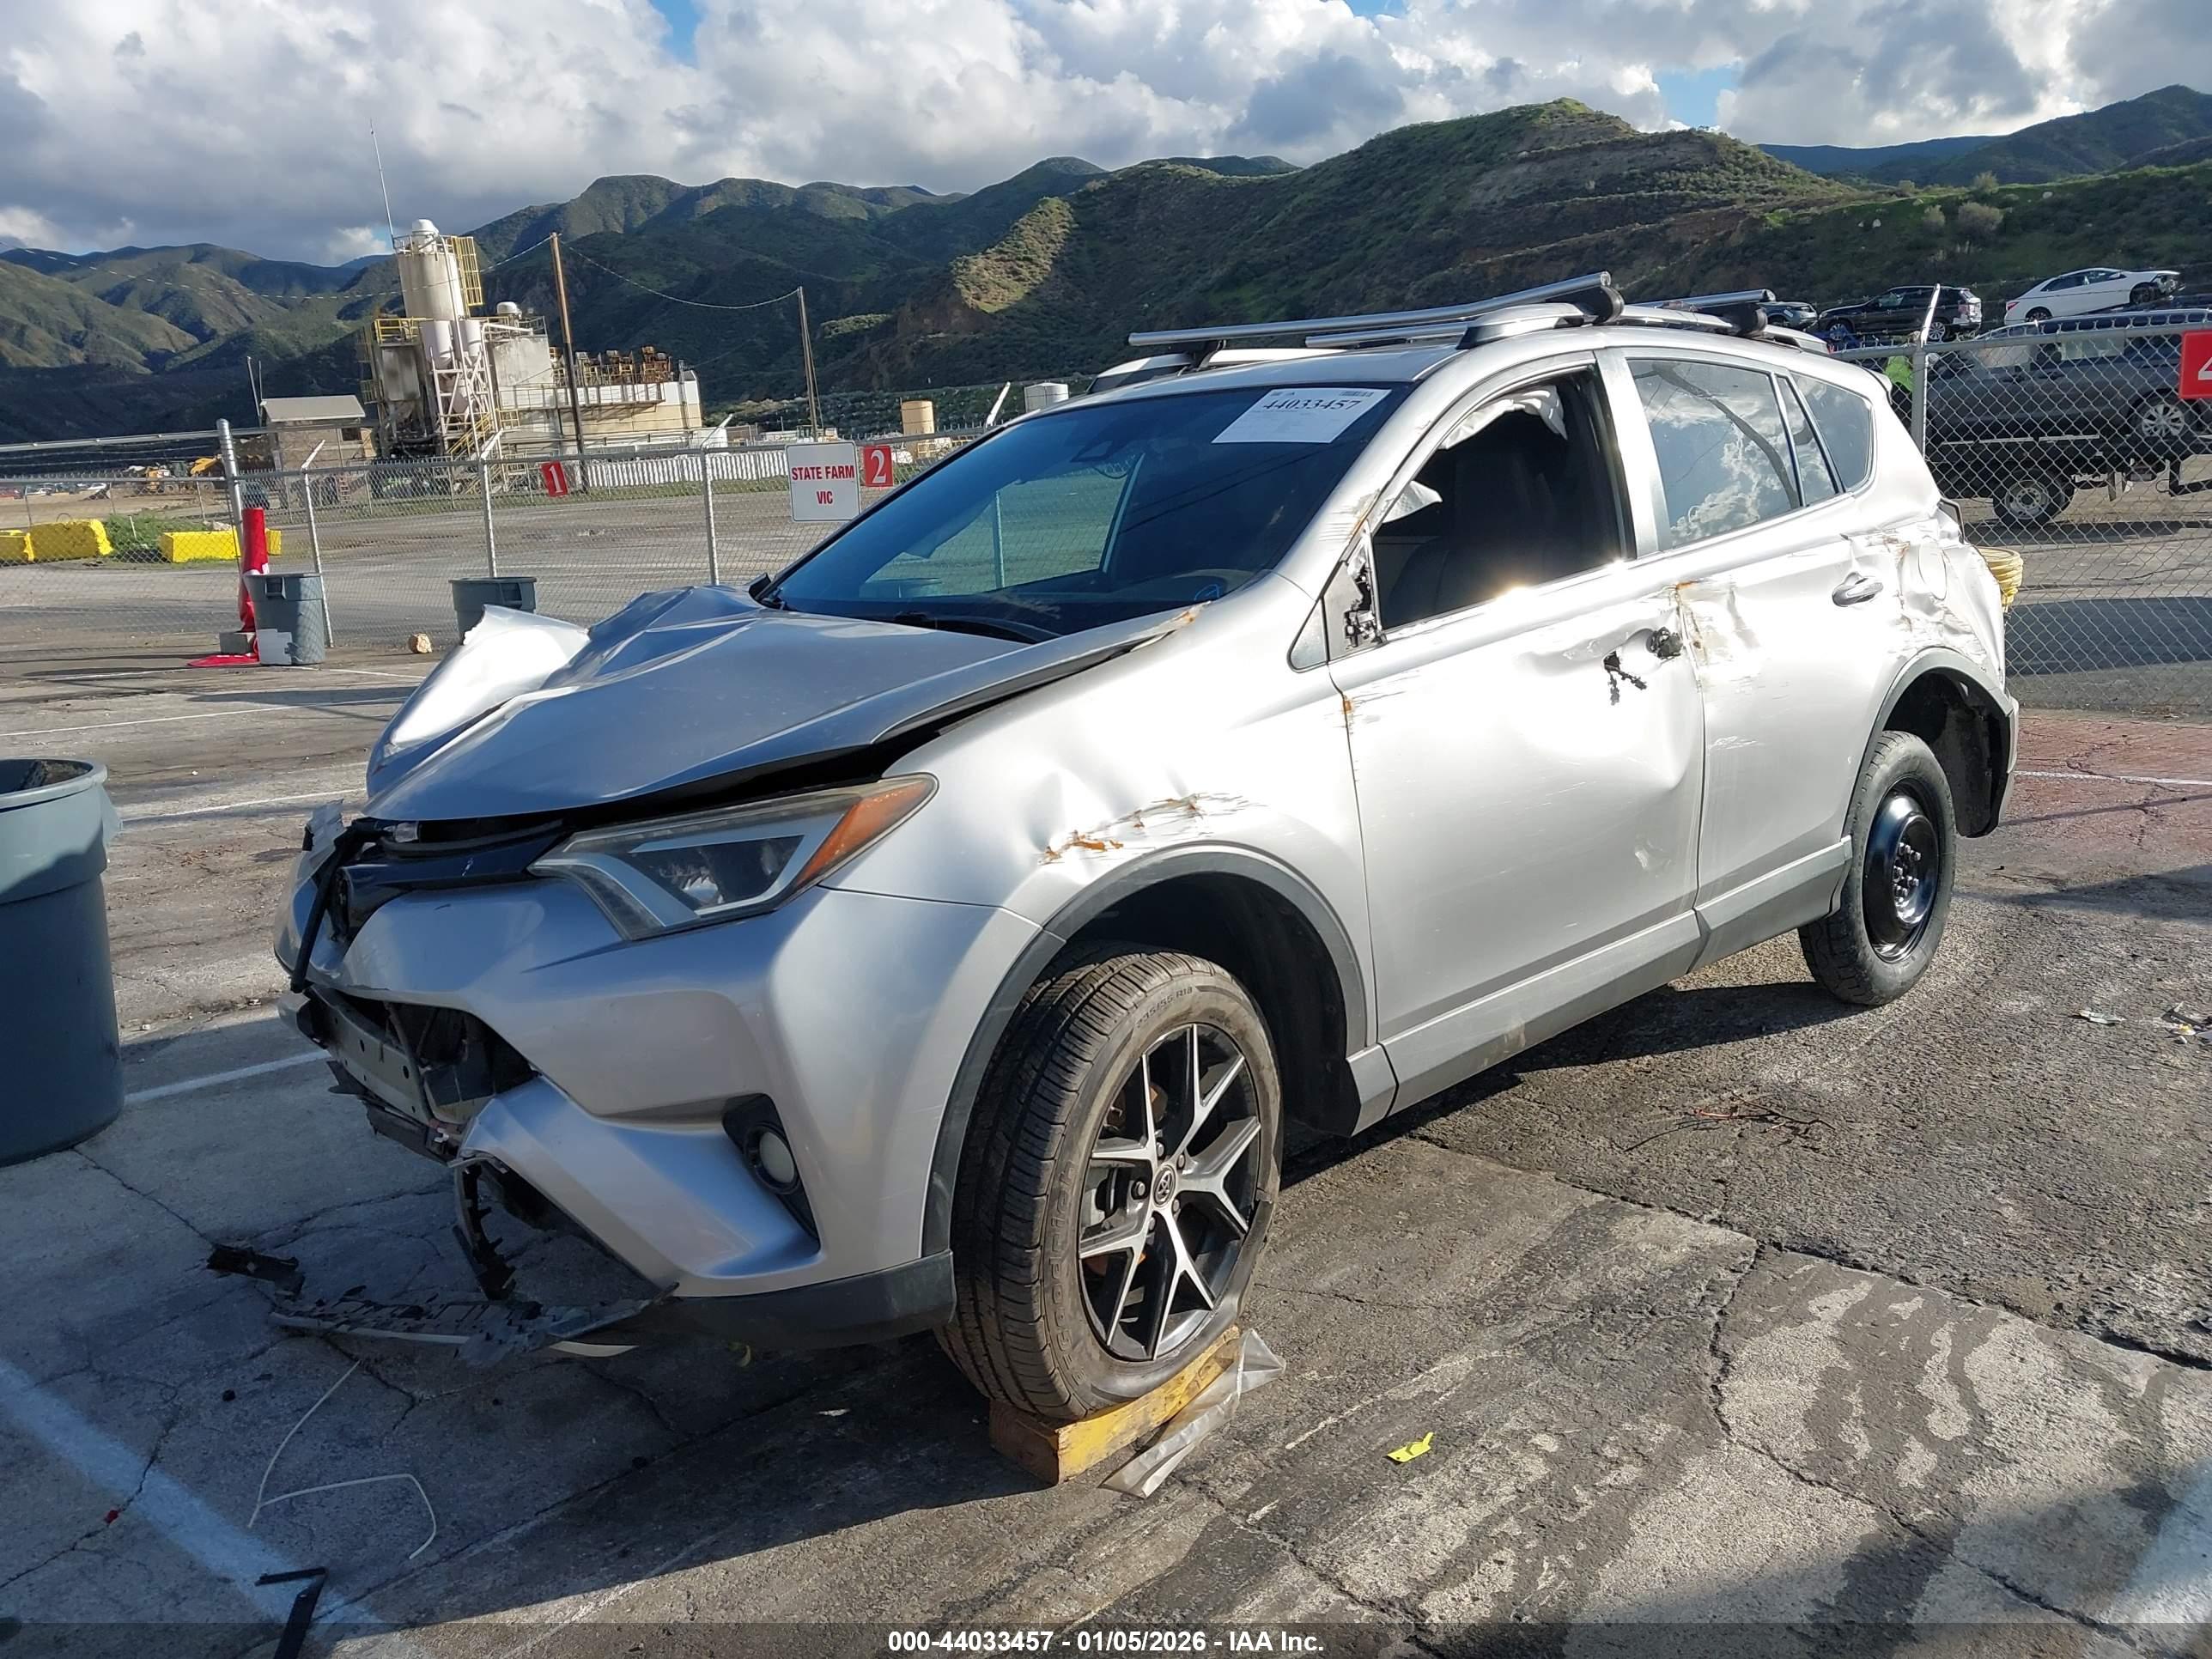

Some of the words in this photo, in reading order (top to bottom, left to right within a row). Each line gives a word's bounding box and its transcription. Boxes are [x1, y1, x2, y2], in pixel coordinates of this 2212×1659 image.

[1263, 398, 1362, 410] 44033457
[791, 466, 823, 481] STATE
[824, 465, 855, 480] FARM
[870, 449, 887, 483] 2
[549, 465, 564, 493] 1
[816, 490, 834, 505] VIC
